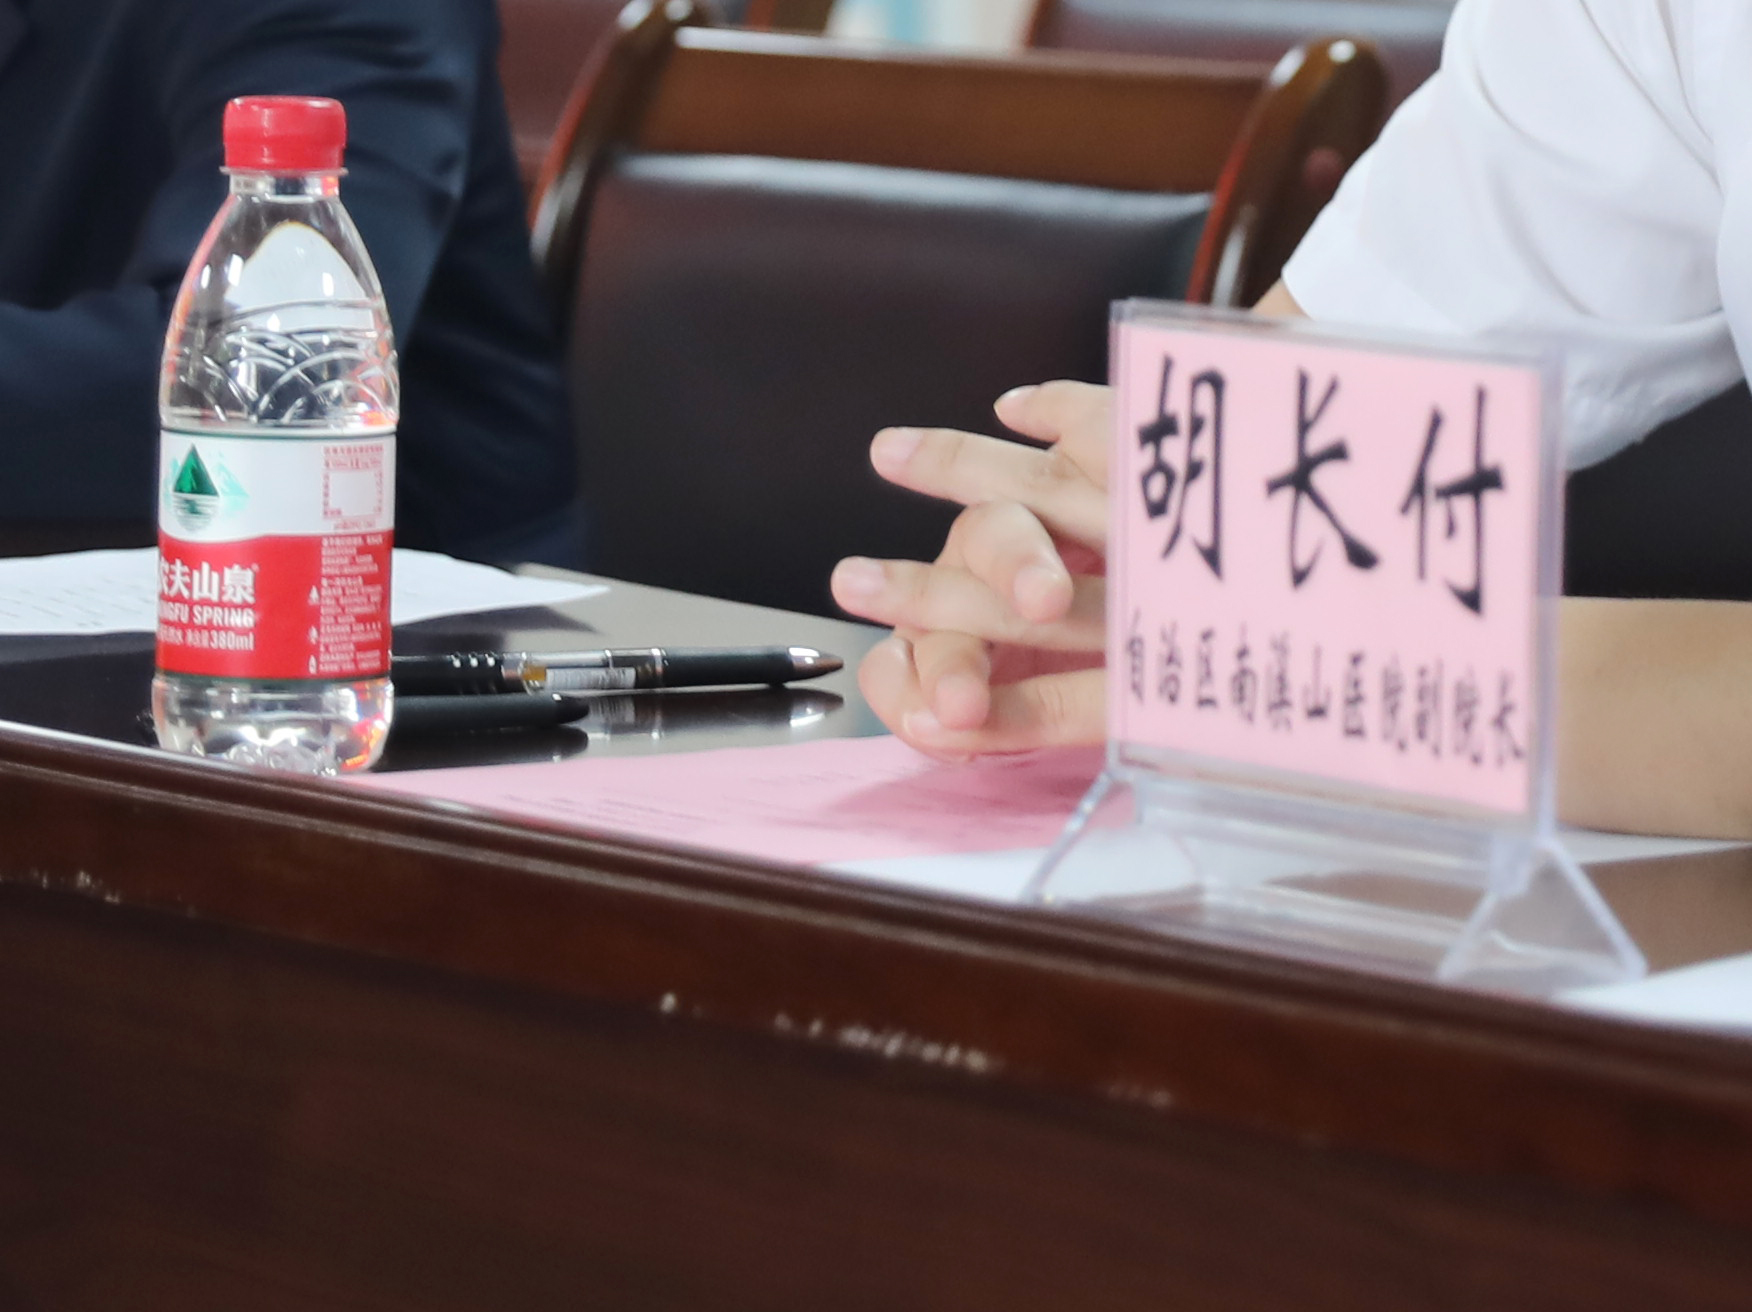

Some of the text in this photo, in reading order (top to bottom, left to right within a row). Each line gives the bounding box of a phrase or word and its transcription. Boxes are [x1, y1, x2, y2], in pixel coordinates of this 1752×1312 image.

[1137, 352, 1506, 616] 胡长付
[192, 604, 255, 629] SPRING
